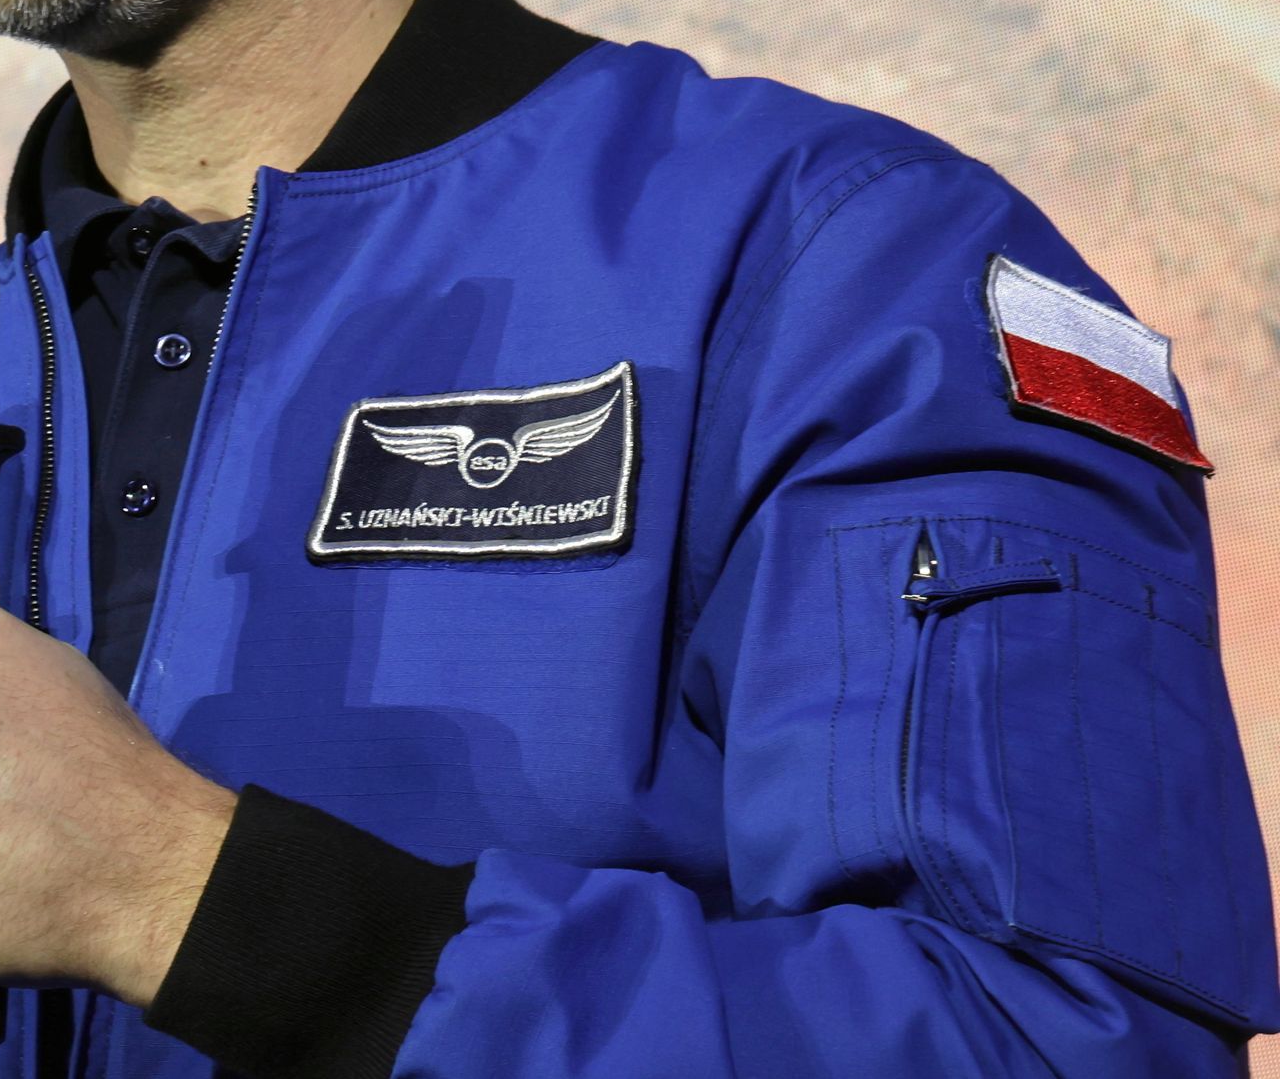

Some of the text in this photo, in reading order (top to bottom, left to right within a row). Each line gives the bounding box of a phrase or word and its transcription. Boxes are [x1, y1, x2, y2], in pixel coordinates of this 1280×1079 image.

[469, 455, 508, 471] esa
[335, 495, 611, 530] S. UZNAŃSKI-WIŚNIEWSKI
